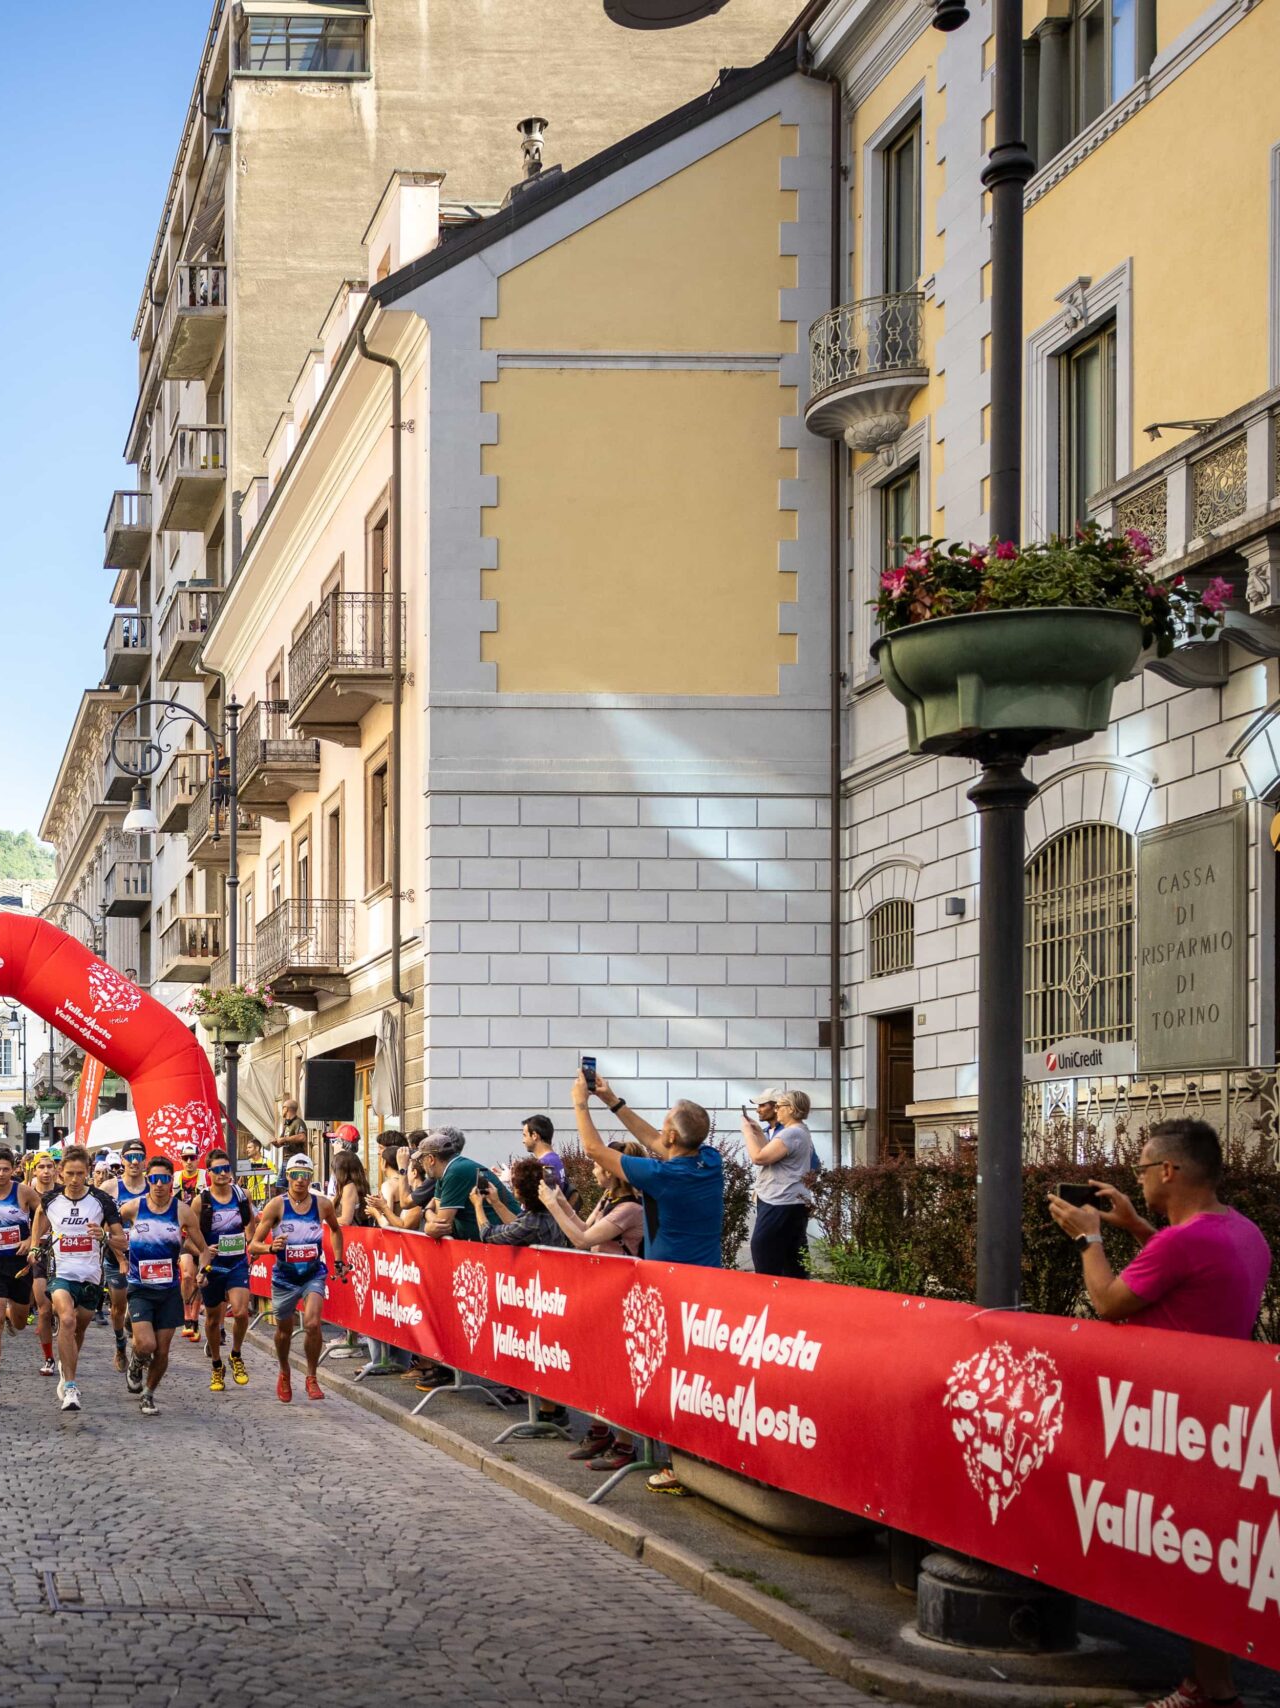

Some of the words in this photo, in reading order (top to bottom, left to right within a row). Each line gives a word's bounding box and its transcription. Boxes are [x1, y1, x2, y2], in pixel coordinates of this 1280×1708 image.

[1157, 864, 1216, 896] CASSA
[1176, 903, 1195, 926] DI
[1142, 930, 1233, 966] RISPARMIO
[1176, 972, 1195, 995] DI
[63, 998, 85, 1019] Valle
[1151, 1003, 1220, 1031] TORINO
[1058, 1048, 1103, 1070] UniCredit
[60, 1217, 90, 1225] FUGA
[61, 1238, 79, 1247] 294
[288, 1250, 305, 1258] 248
[495, 1271, 525, 1312] Valle
[525, 1269, 567, 1319] d'Aosta
[492, 1321, 526, 1362] Vallée
[526, 1323, 571, 1374] d'Aoste
[680, 1301, 730, 1356] Valle
[729, 1304, 822, 1372] d'Aosta
[670, 1367, 726, 1423] Vallée
[727, 1376, 817, 1449] d'Aoste
[1098, 1376, 1207, 1462] Valle
[1067, 1472, 1213, 1574] Vallée
